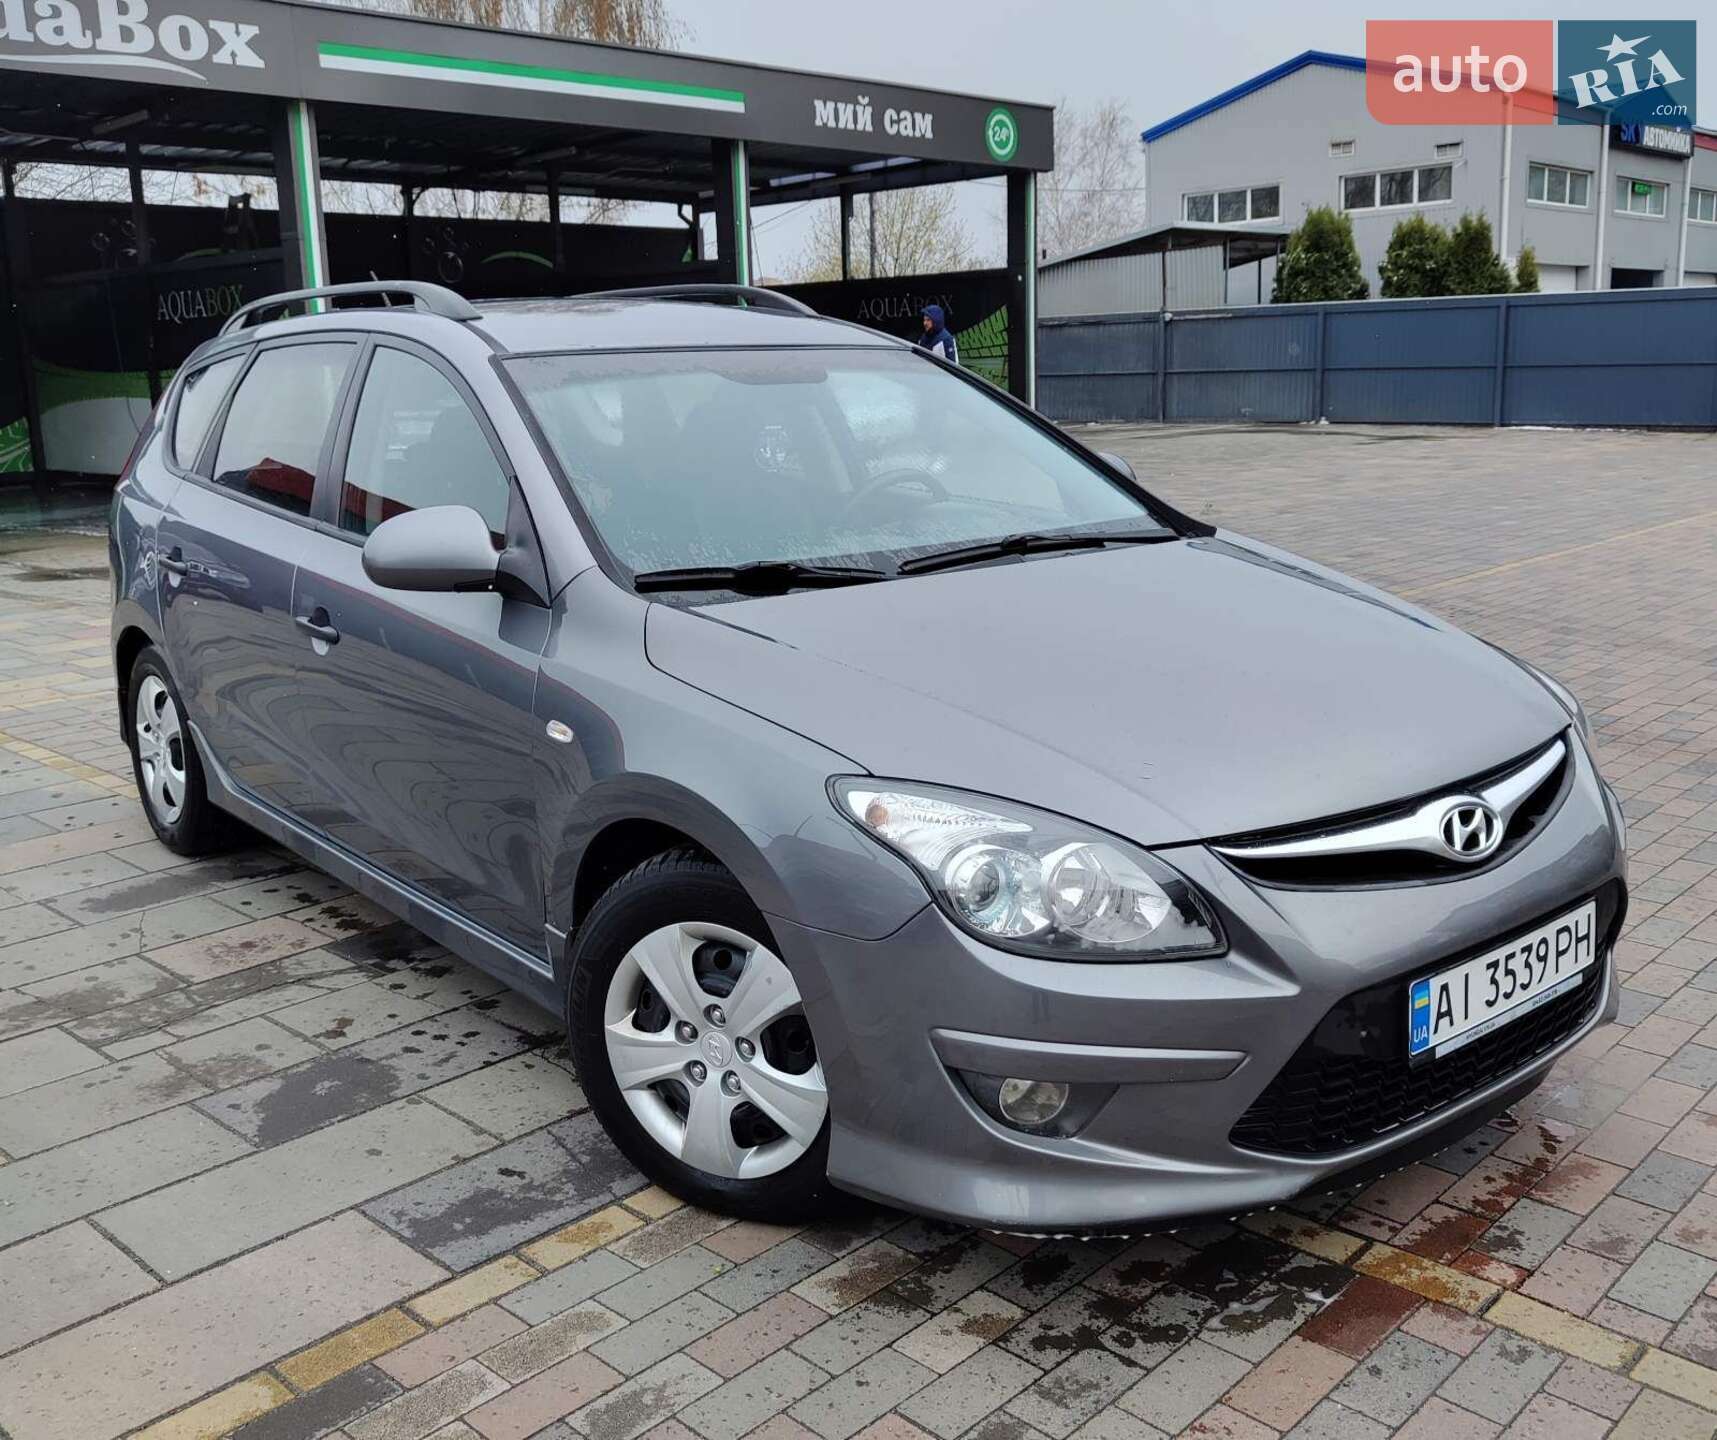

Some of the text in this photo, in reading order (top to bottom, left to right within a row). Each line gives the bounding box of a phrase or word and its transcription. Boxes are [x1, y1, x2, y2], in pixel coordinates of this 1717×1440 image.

[814, 95, 934, 139] мий сам
[1433, 912, 1592, 1036] AI 3539 PH
[1413, 1025, 1428, 1043] UA
